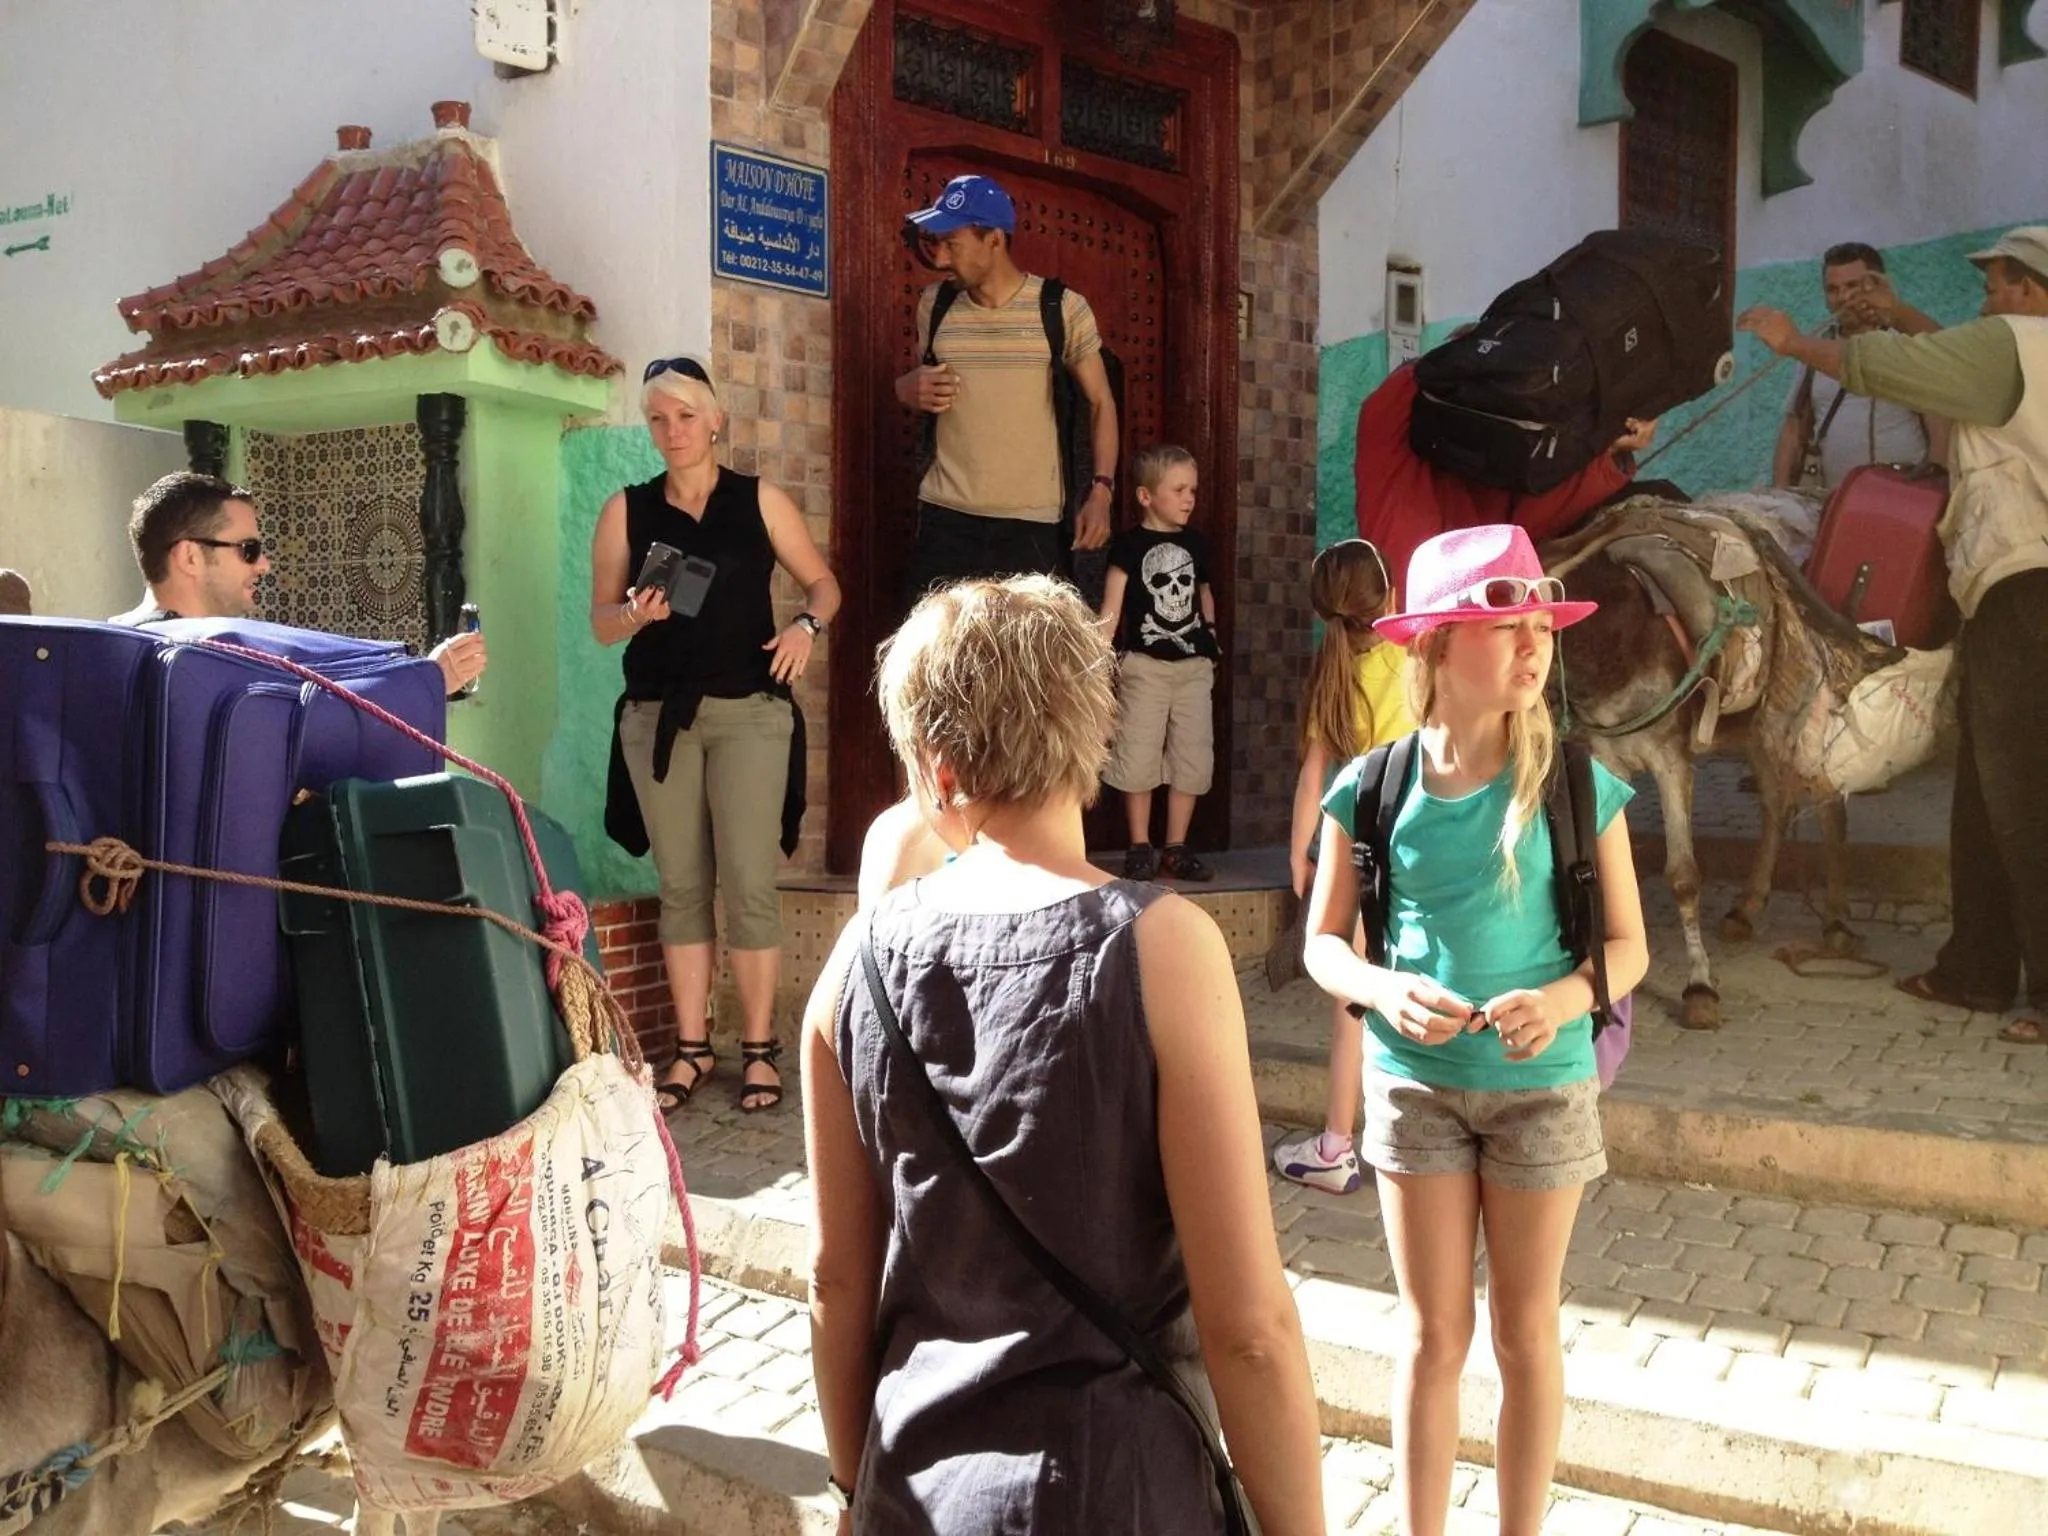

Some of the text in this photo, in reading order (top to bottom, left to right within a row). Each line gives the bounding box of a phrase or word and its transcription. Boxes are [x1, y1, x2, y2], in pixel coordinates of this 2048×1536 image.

[725, 159, 774, 193] MAISON
[410, 1261, 434, 1284] Kg
[452, 1232, 484, 1291] LUXE
[408, 1292, 433, 1322] 25
[447, 1298, 476, 1327] DE
[417, 1374, 461, 1438] TNDRE
